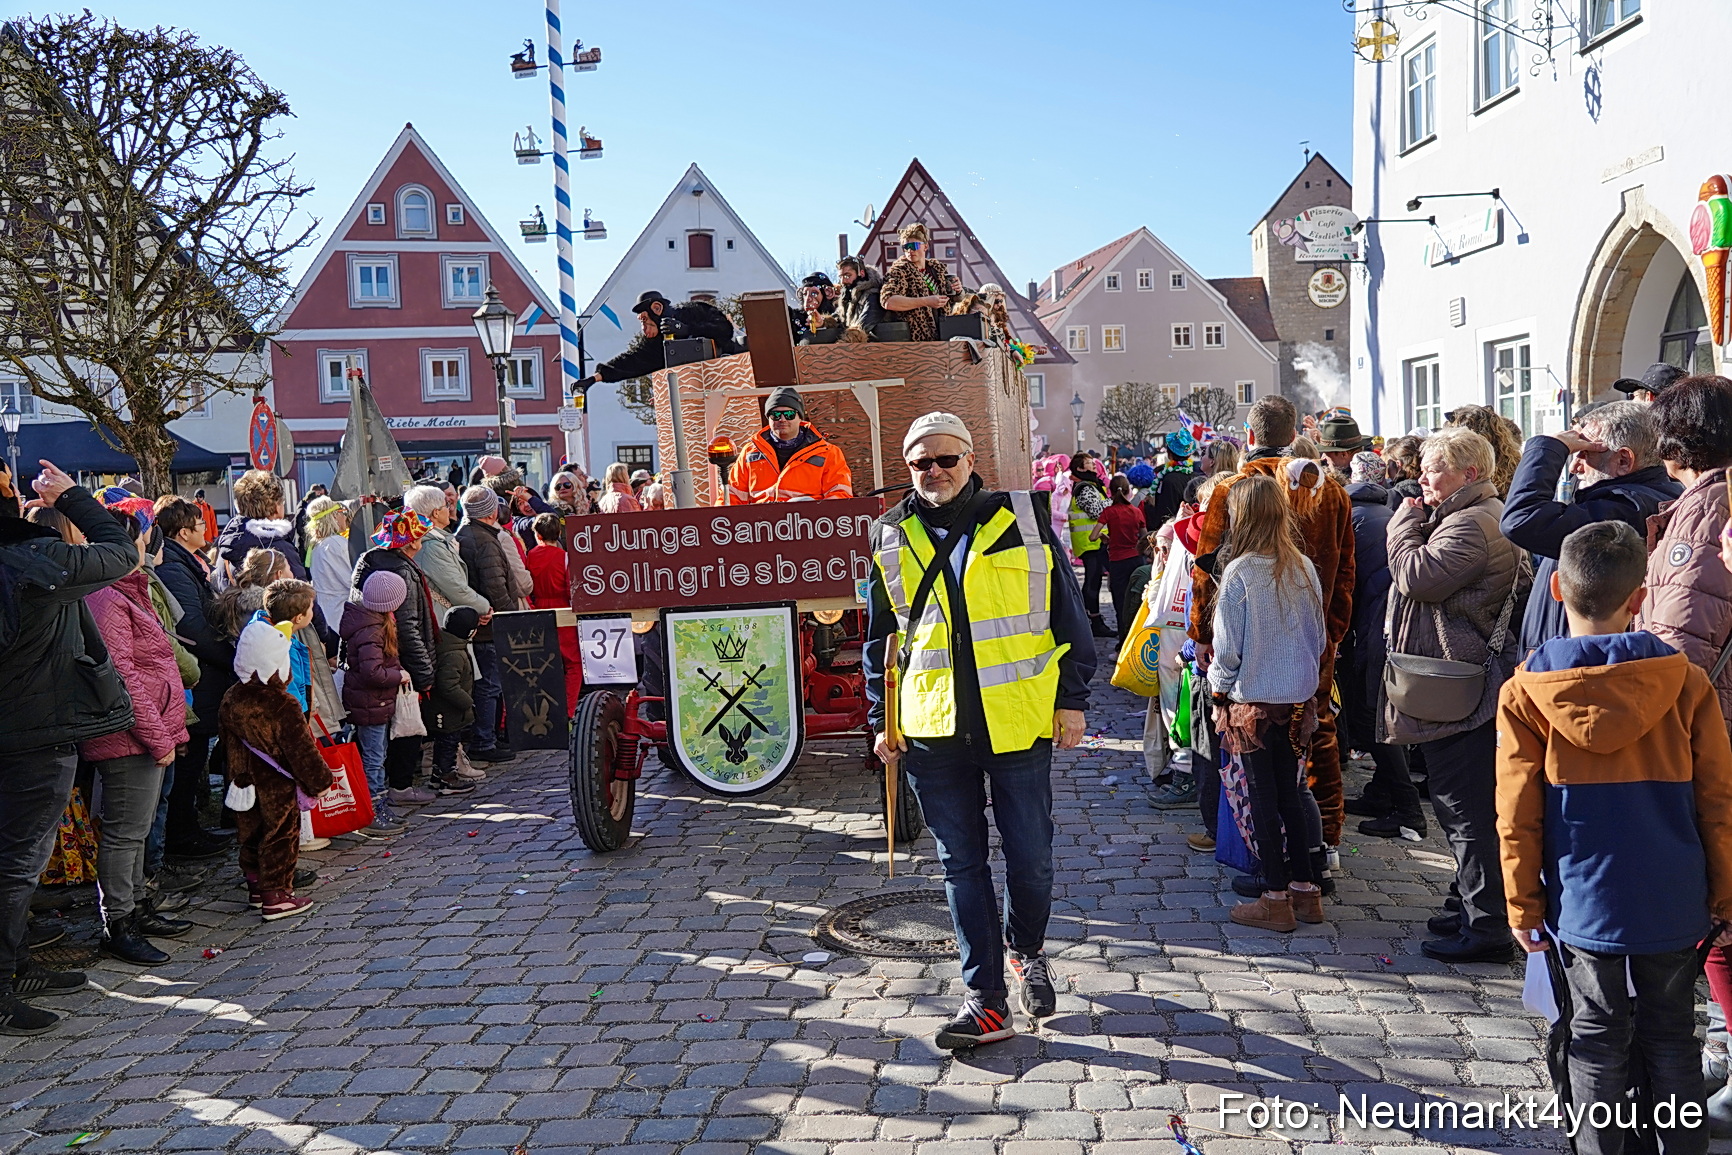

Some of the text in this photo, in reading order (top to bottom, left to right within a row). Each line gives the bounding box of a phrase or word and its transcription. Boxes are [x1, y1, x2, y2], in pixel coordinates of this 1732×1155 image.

[1309, 208, 1343, 218] Pizzeria
[1317, 220, 1336, 229] Café
[1308, 230, 1344, 240] Eisdiele
[384, 416, 467, 428] Riebe Moden
[711, 512, 873, 545] Sandhosn
[583, 550, 870, 597] Sollngriesbach
[700, 622, 758, 633] EST 1198
[590, 628, 627, 660] 37
